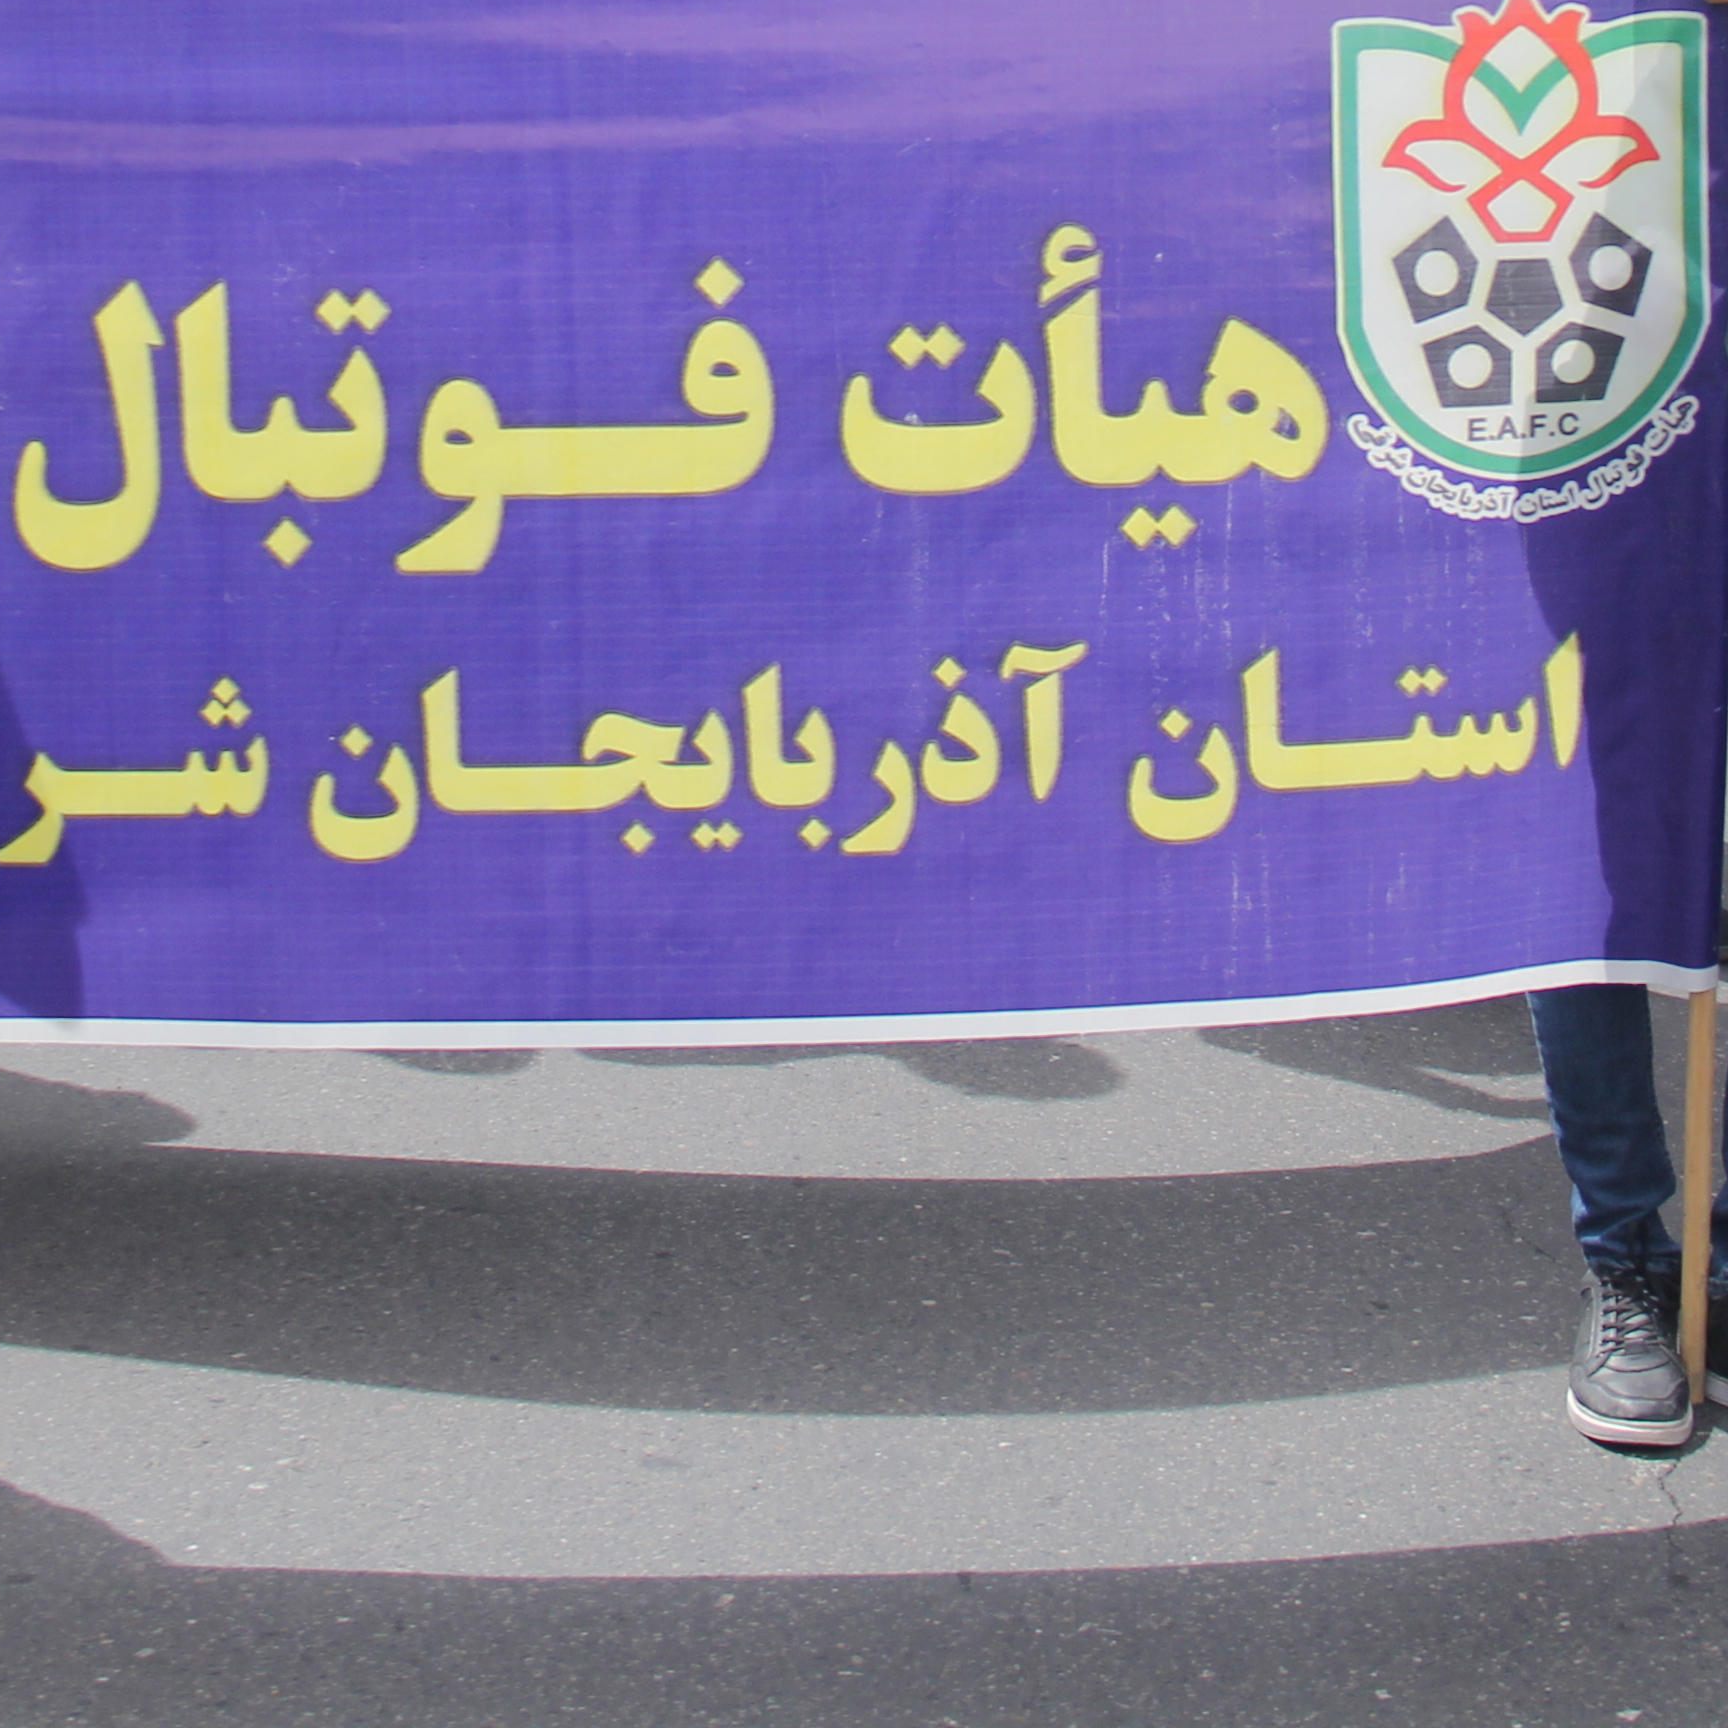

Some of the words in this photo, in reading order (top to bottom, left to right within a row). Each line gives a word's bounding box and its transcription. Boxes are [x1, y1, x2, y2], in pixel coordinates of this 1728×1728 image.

[15, 262, 772, 571] فوتبال
[842, 227, 1327, 546] هیأت
[1467, 412, 1581, 443] E.A.F.C
[1517, 484, 1577, 518] استان
[311, 645, 1084, 859] آذربایجان
[1129, 637, 1580, 840] استان
